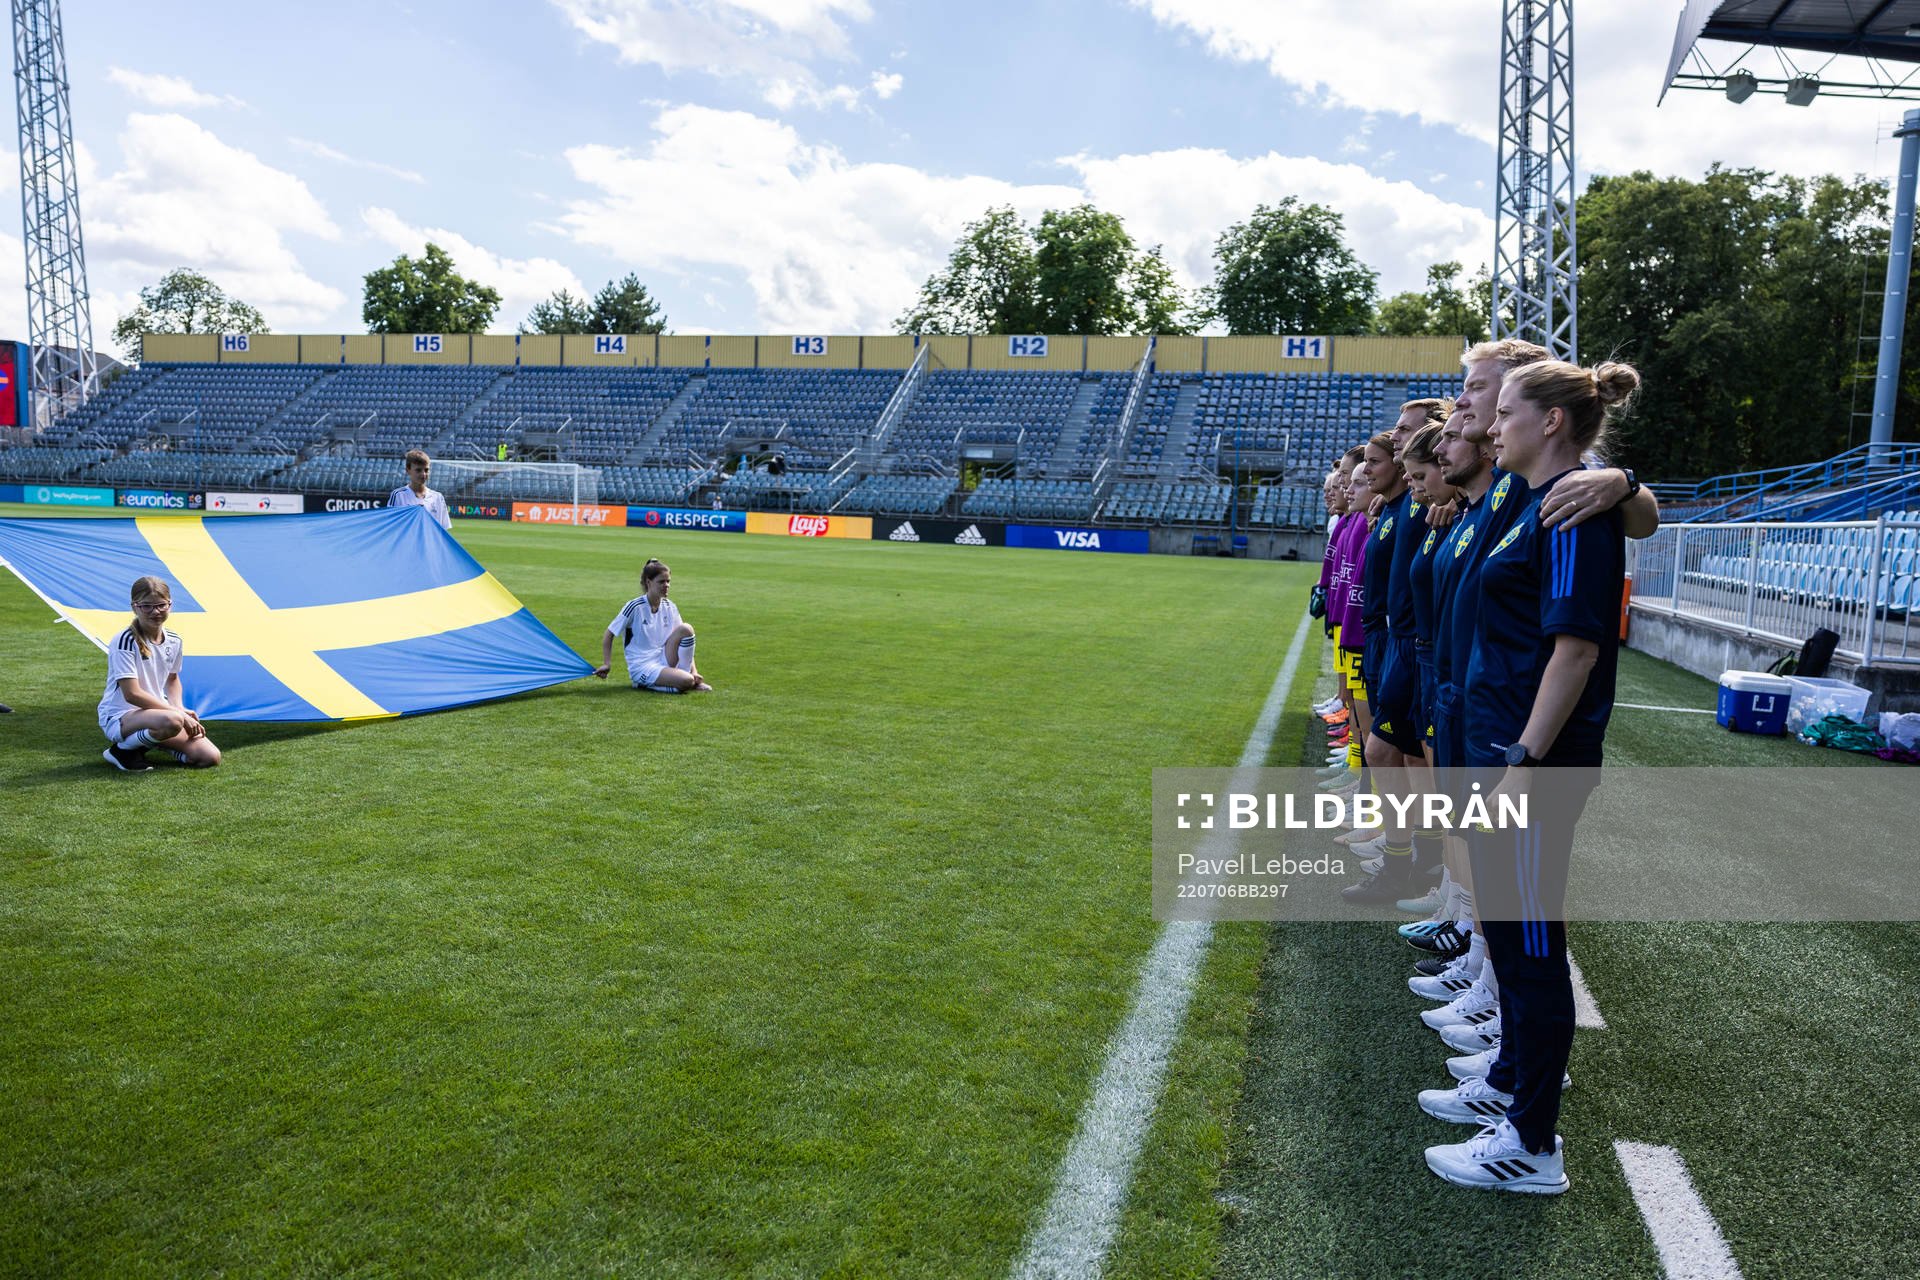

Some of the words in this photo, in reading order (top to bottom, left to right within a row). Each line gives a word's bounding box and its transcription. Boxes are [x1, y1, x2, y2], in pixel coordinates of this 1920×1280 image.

[224, 335, 248, 351] H6
[415, 336, 440, 352] H5
[596, 336, 624, 353] H4
[795, 337, 824, 354] H3
[1011, 337, 1045, 355] H2
[1287, 338, 1321, 357] H1
[126, 492, 185, 508] euronics
[545, 507, 581, 522] JUST
[582, 508, 610, 522] EAT
[665, 512, 729, 528] RESPECT
[790, 514, 828, 537] Lay's
[889, 533, 920, 542] adidas
[954, 536, 986, 545] adidas
[1054, 530, 1101, 549] VISA
